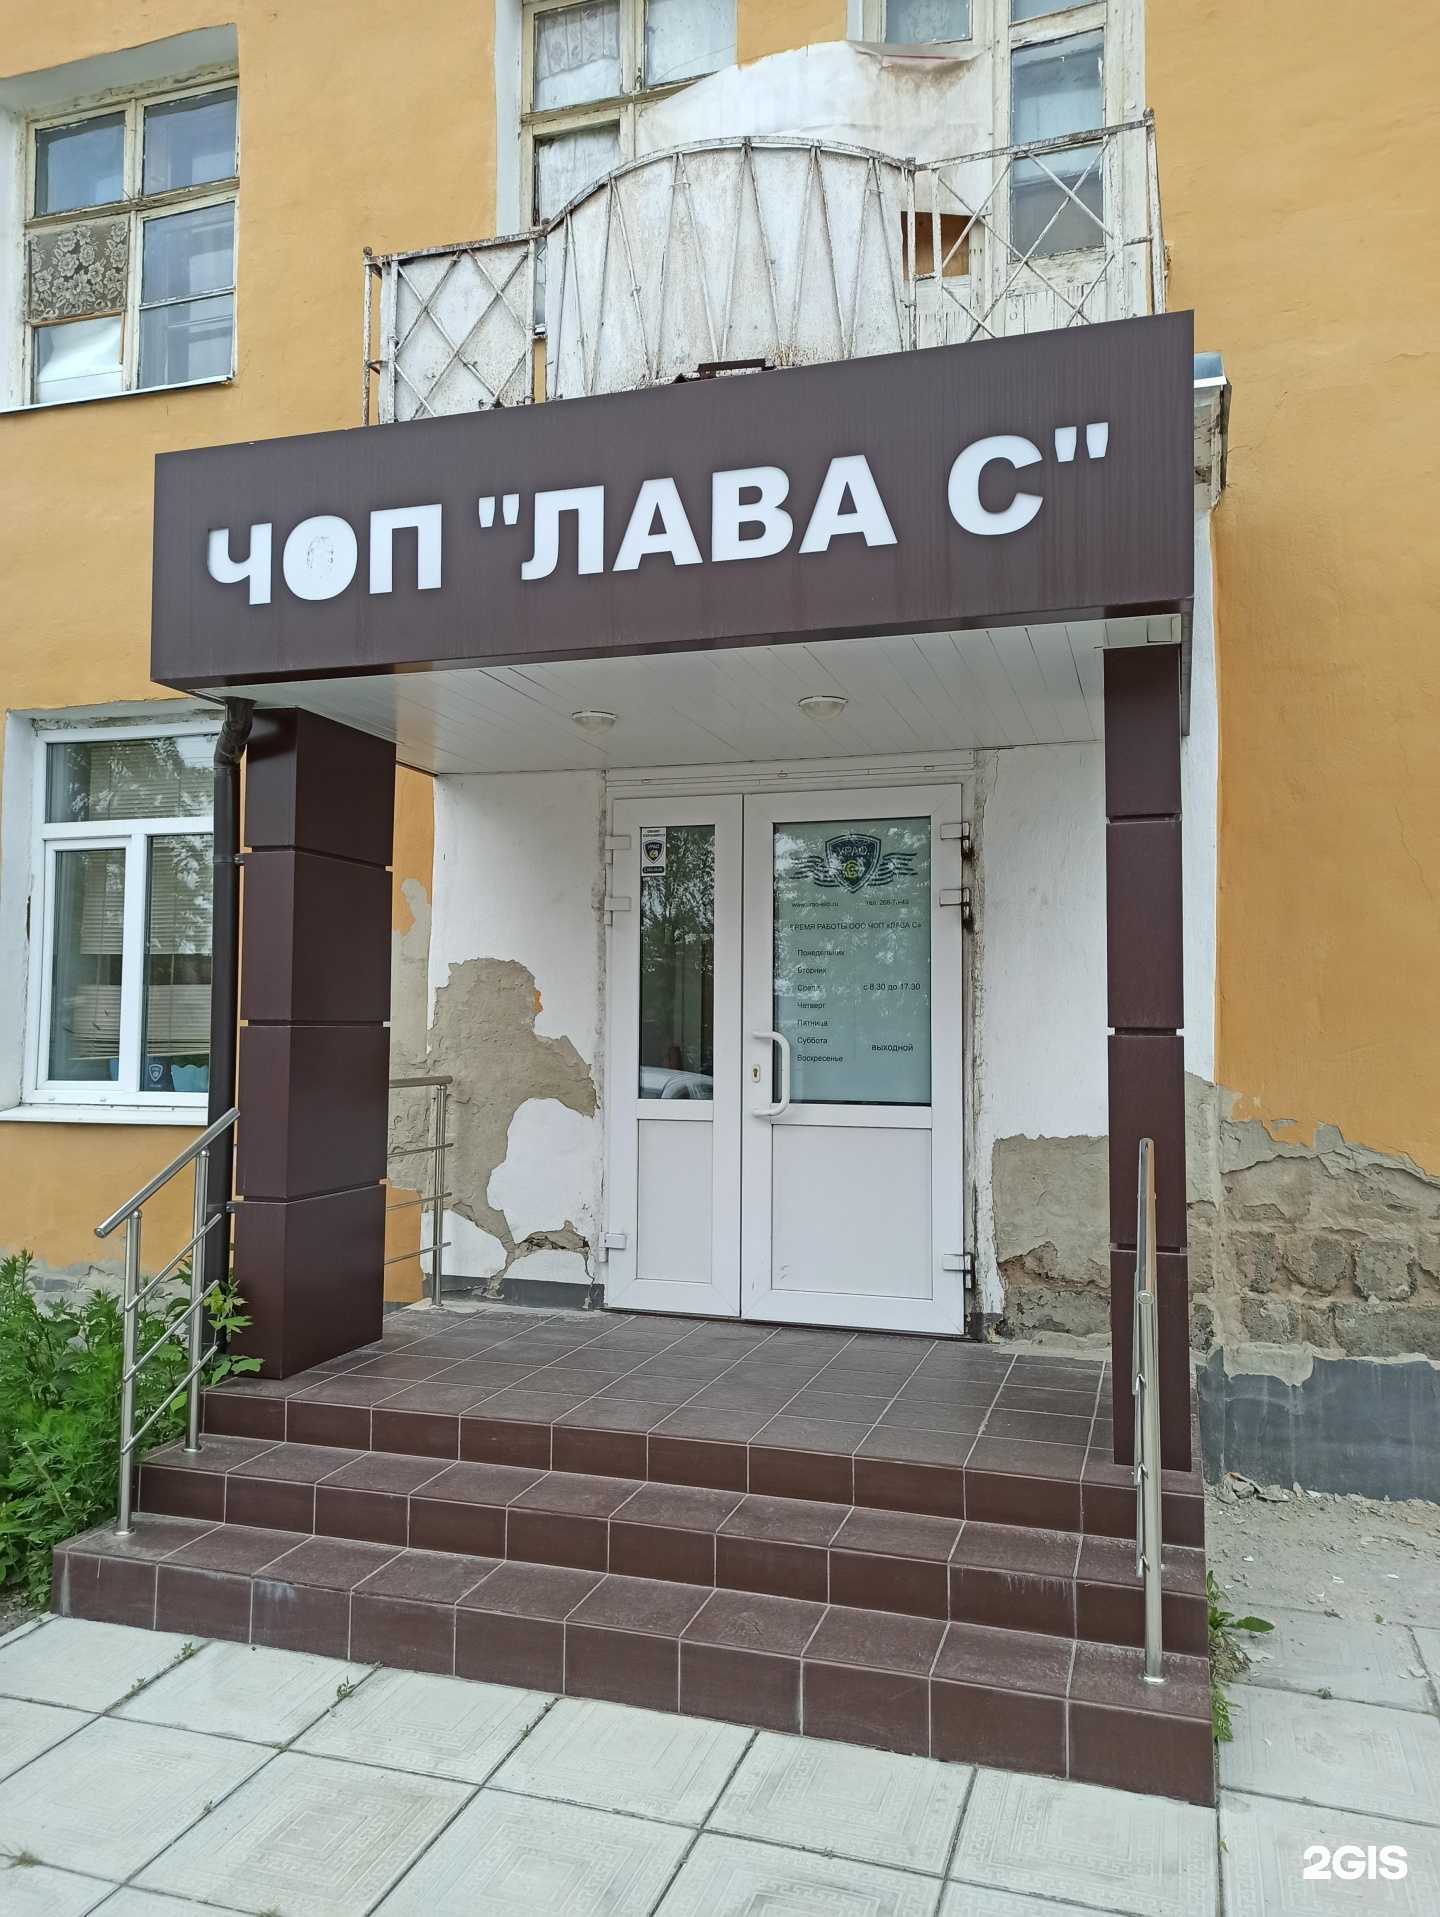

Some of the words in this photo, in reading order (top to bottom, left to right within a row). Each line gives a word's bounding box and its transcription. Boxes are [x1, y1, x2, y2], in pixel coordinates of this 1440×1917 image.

[209, 504, 442, 604] ЧОП
[479, 455, 897, 579] "ЛАВА
[948, 423, 1108, 535] С"
[817, 922, 848, 931] РАБОТЫ
[848, 922, 867, 930] ООО
[867, 921, 885, 929] ЧОП
[797, 949, 845, 957] Понедельник
[797, 966, 827, 974] Вторник
[887, 983, 898, 991] до
[900, 982, 921, 991] 17.30
[797, 1001, 825, 1009] Четверг
[797, 1019, 829, 1027] Пятница
[797, 1036, 828, 1045] Суббота
[871, 1043, 914, 1053] выходной
[797, 1054, 844, 1063] Воскресенье
